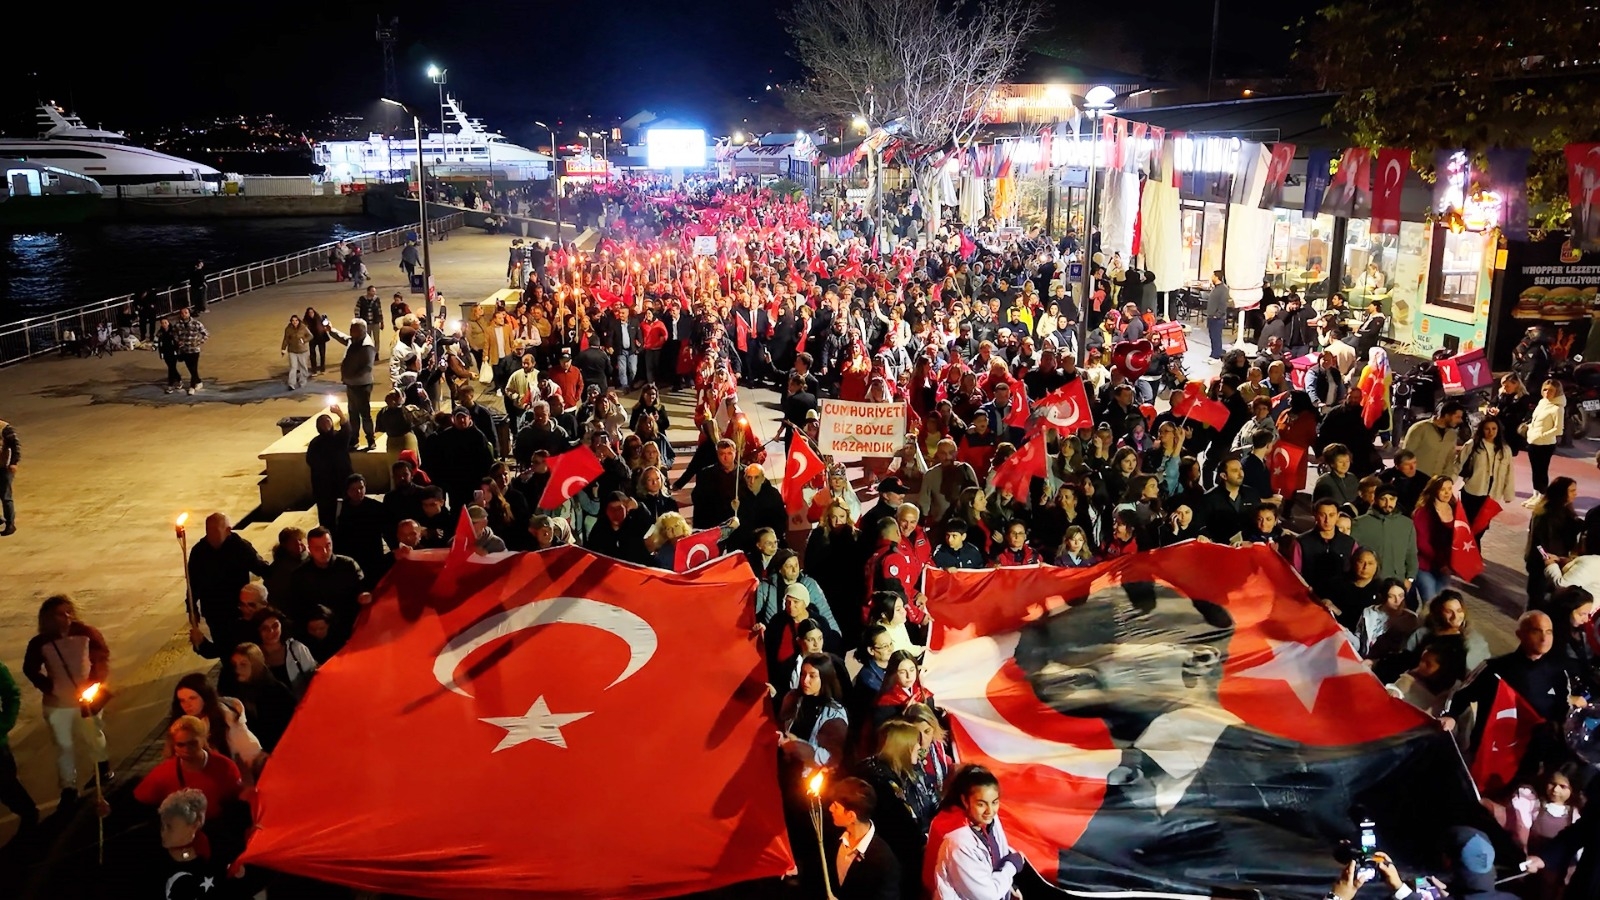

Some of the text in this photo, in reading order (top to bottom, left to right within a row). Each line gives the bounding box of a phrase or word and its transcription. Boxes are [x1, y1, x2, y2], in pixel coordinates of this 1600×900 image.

[1522, 265, 1563, 275] WHOPPER
[824, 403, 905, 418] CUMHURİYETİ
[833, 420, 894, 435] BİZ BÖYLE
